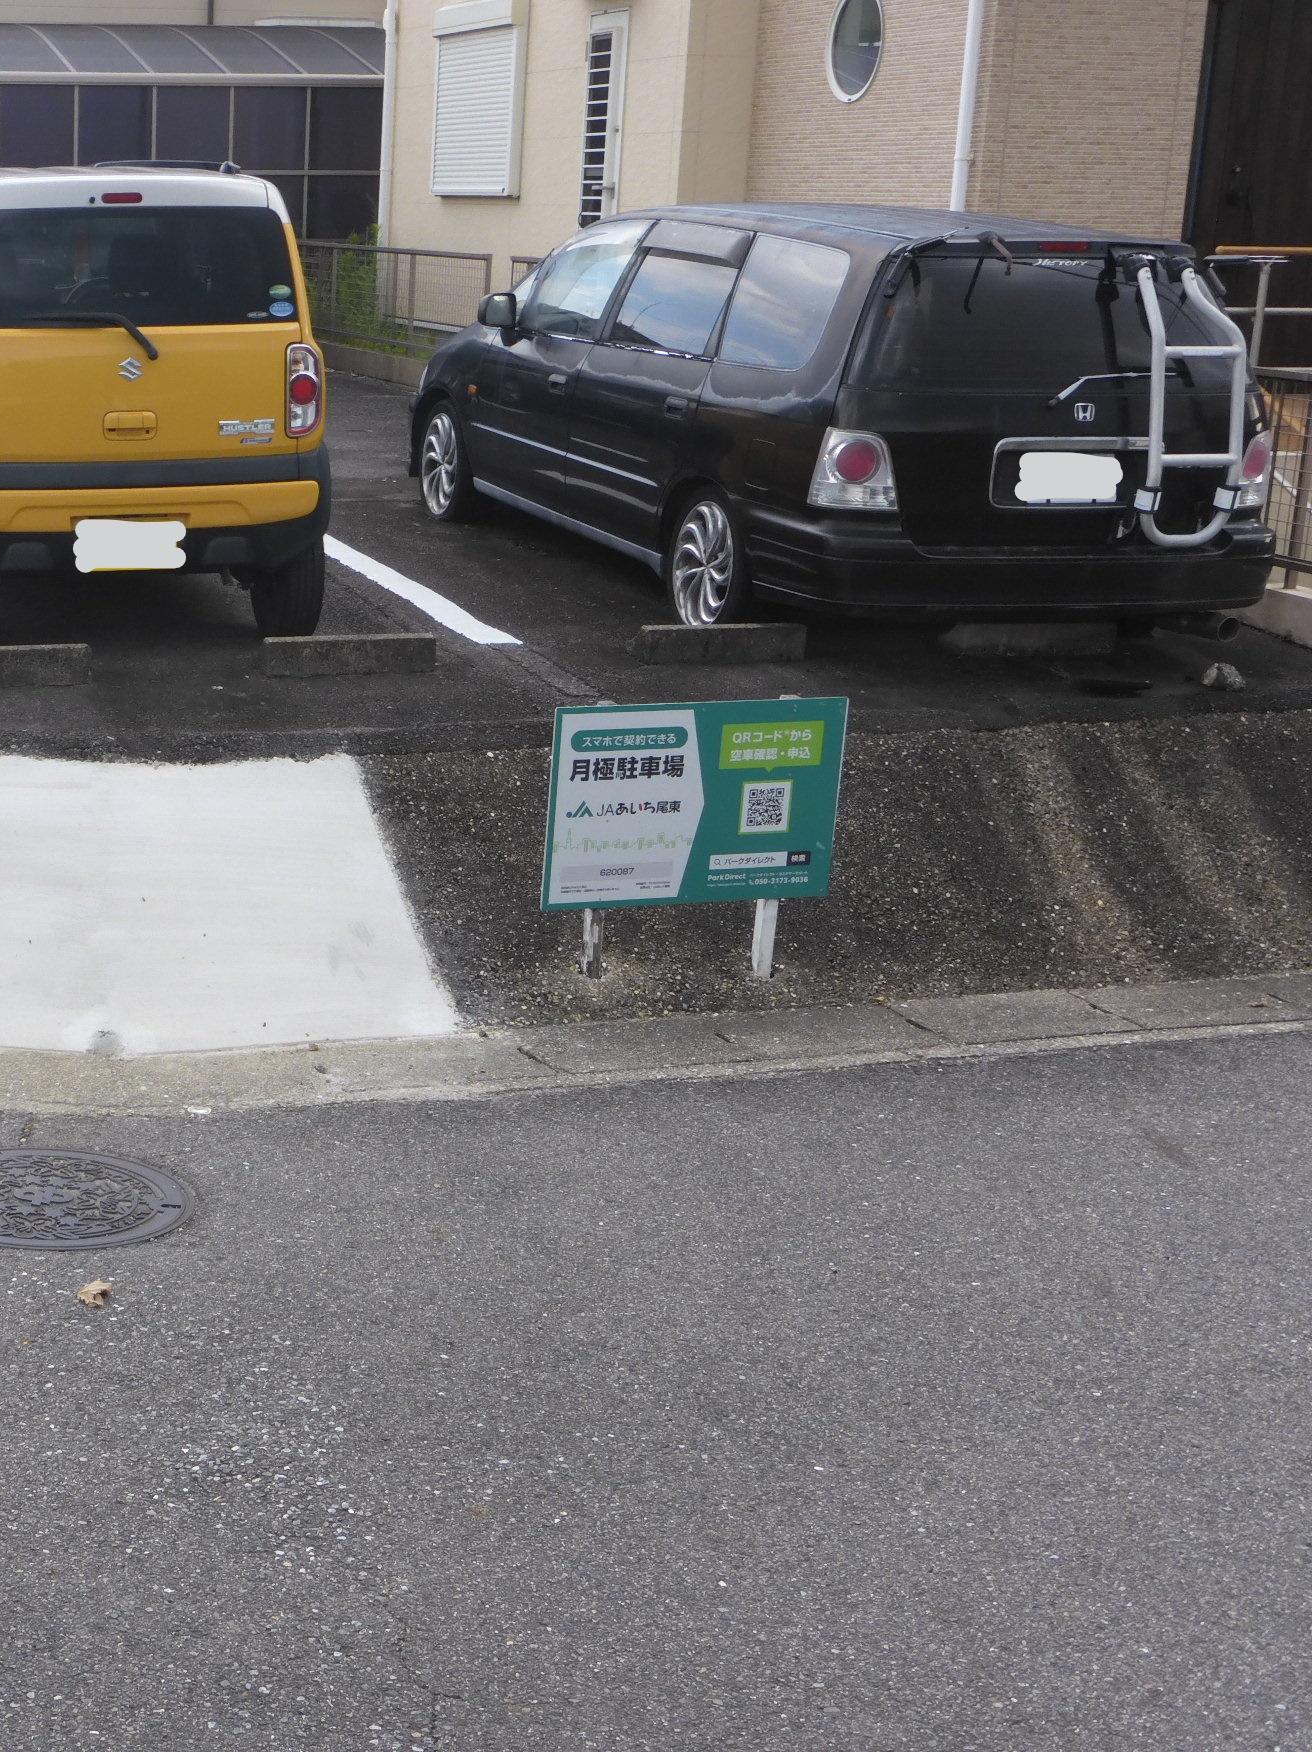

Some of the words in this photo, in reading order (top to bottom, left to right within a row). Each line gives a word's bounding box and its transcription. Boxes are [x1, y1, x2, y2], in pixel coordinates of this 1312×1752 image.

[223, 423, 272, 432] HUSTLER
[582, 733, 677, 748] スマホで契約できる
[569, 755, 685, 782] 月極駐車場
[724, 856, 777, 866] パークダイレクト
[599, 867, 635, 877] 620087
